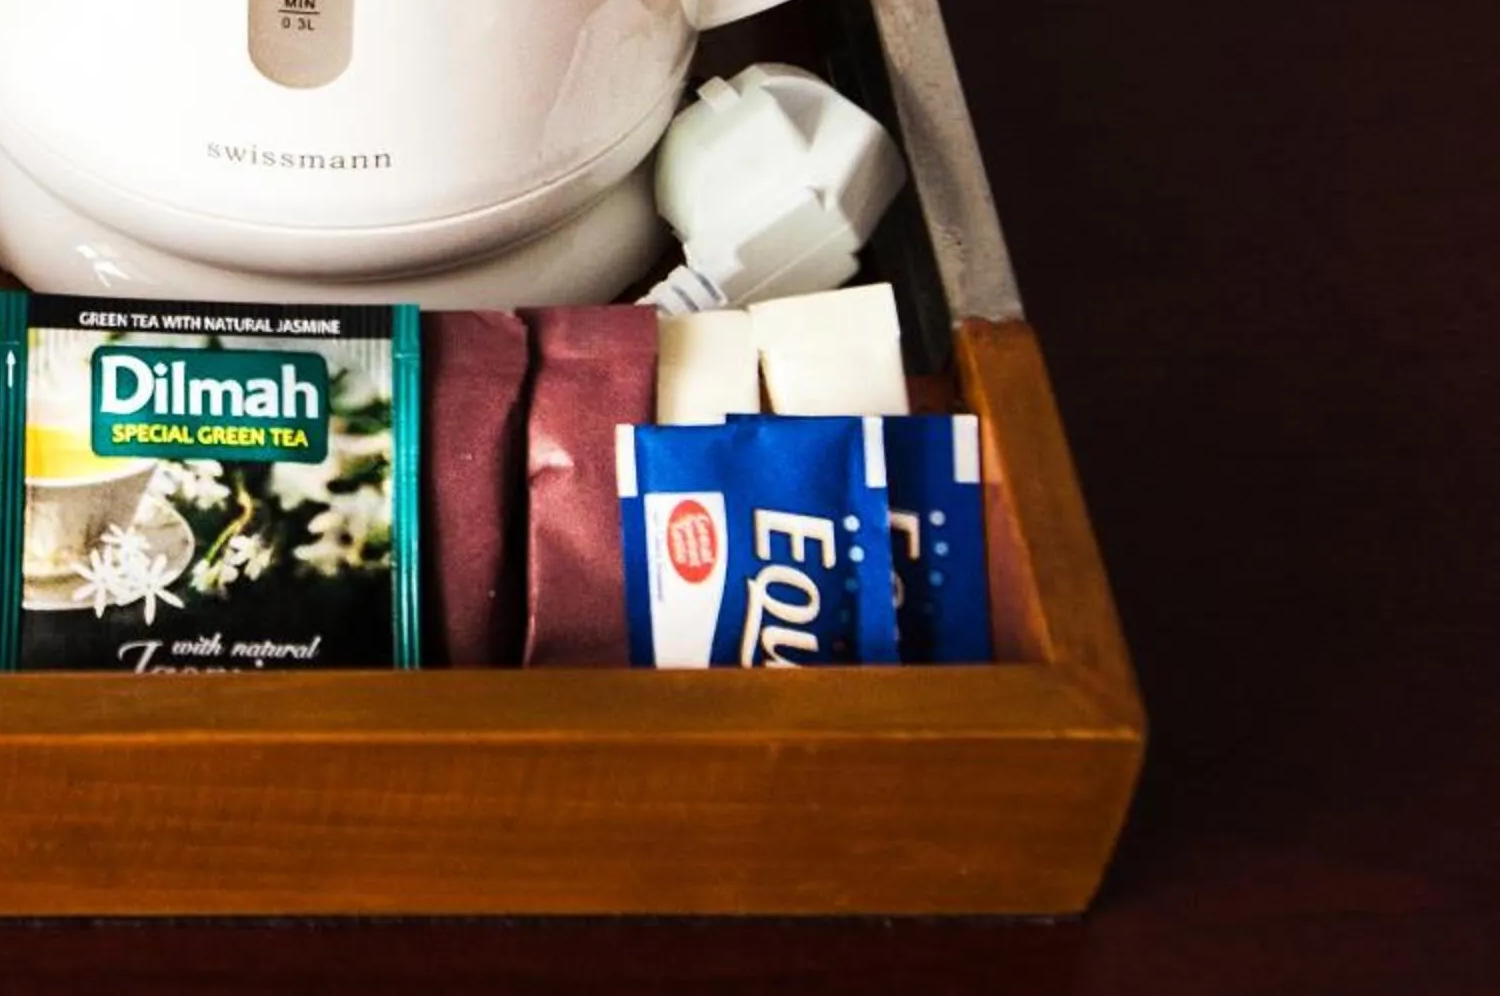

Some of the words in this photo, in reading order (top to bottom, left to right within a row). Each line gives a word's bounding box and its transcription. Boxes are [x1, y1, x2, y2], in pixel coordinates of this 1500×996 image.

[207, 142, 392, 169] swissmann
[79, 311, 128, 328] GREEN
[130, 313, 161, 329] TEA
[162, 315, 202, 331] WITH
[203, 317, 272, 333] NATURAL
[276, 318, 341, 335] JASMINE
[100, 354, 319, 420] Dilmah
[111, 423, 194, 444] SPECIAL
[197, 426, 266, 446] GREEN
[269, 427, 309, 447] TEA
[171, 632, 223, 656] with
[230, 634, 323, 659] natural
